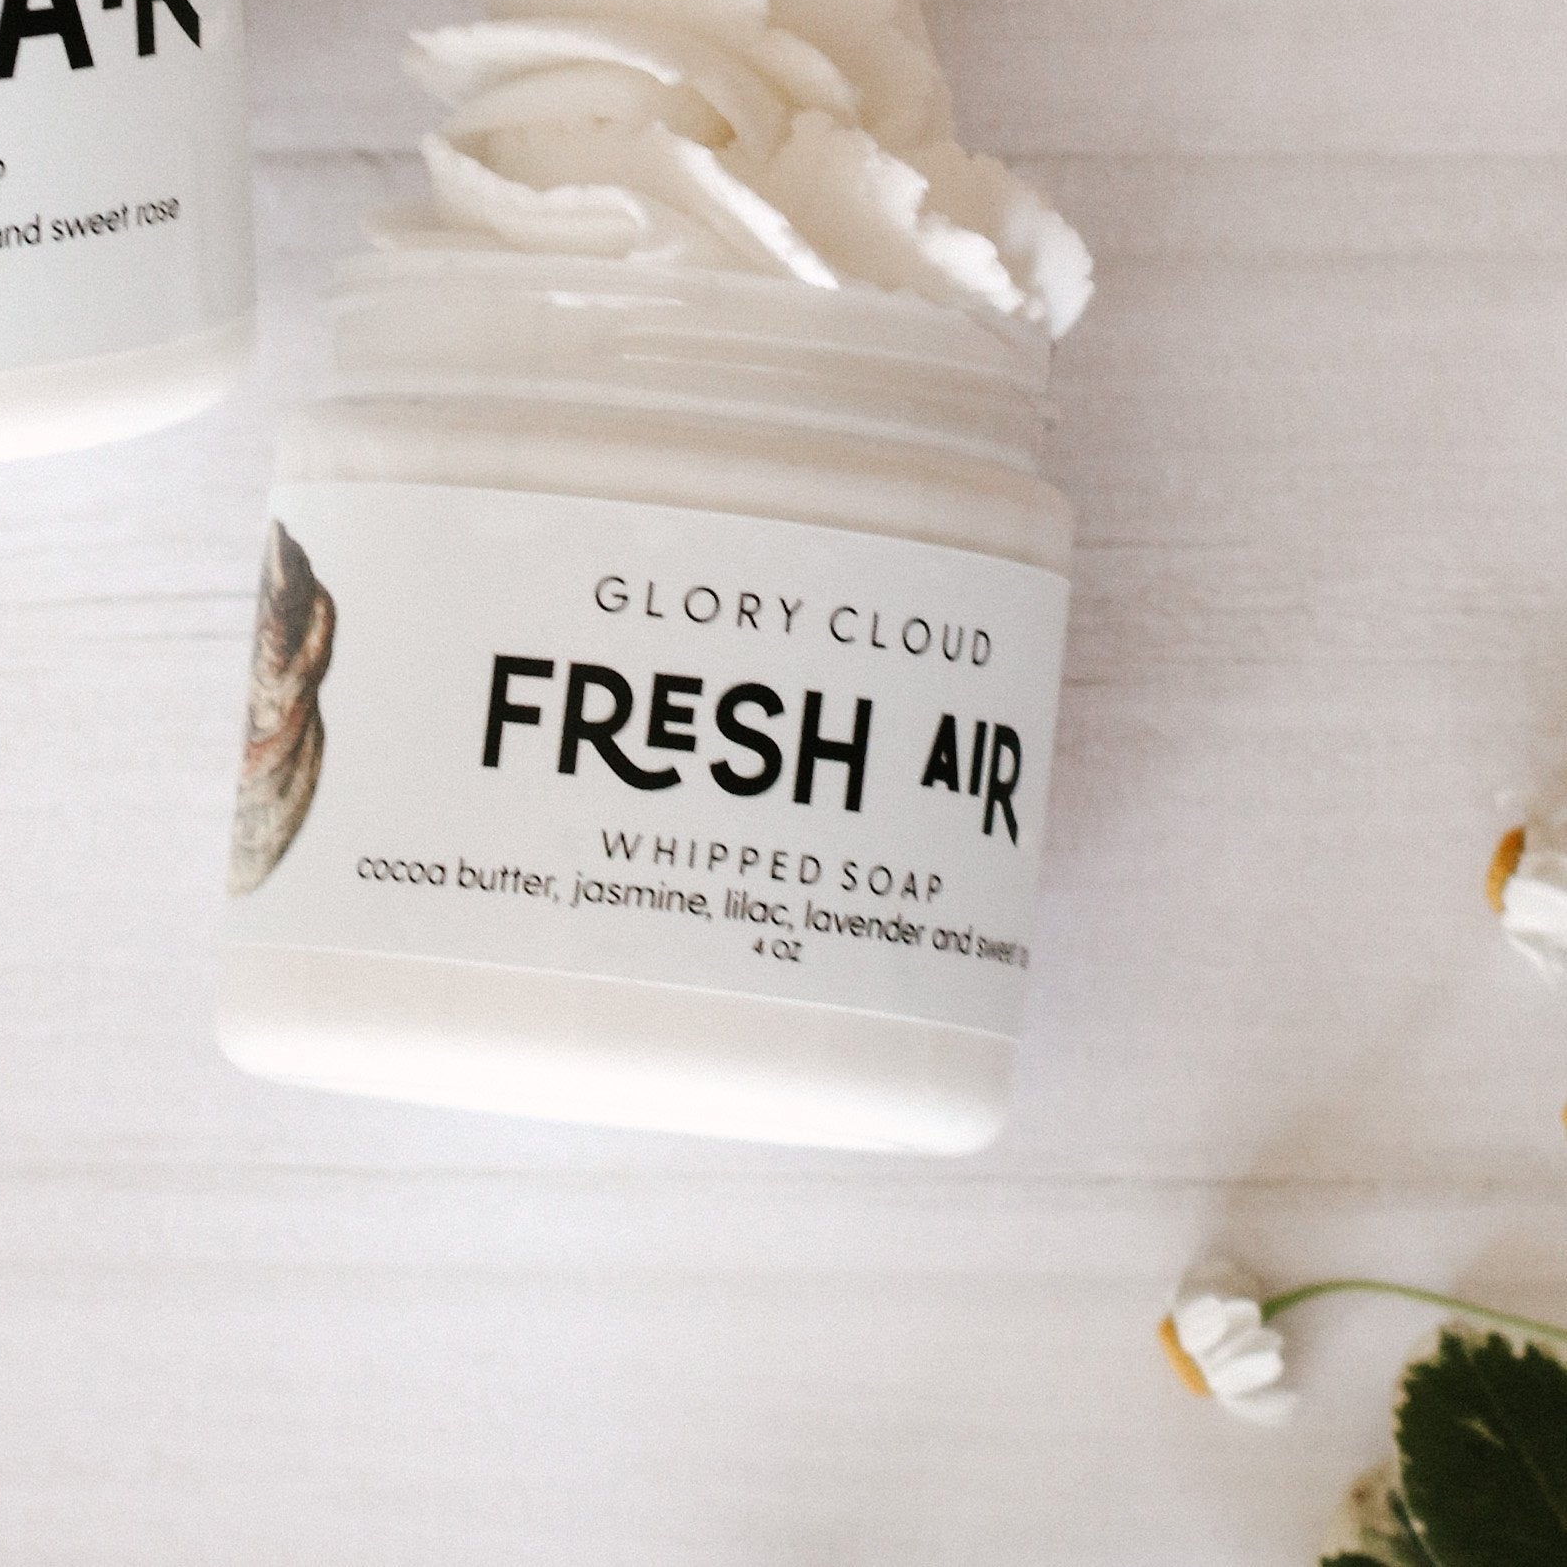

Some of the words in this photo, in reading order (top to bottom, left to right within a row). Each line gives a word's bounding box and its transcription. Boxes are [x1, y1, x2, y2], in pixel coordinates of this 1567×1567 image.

[51, 205, 130, 241] sweet
[135, 196, 182, 227] rose
[594, 575, 805, 636] GLORY
[829, 605, 994, 667] CLOUD
[482, 653, 874, 812] FRESH
[920, 712, 1023, 846] AIR
[357, 857, 445, 884] cocoa
[456, 858, 559, 903] butter,
[569, 870, 712, 920] jasmine,
[724, 886, 794, 930] lilac,
[804, 900, 924, 947] lavender
[932, 924, 973, 955] and
[601, 829, 822, 887] WHIPPED
[840, 861, 946, 903] SOAP
[752, 937, 764, 955] 4
[771, 939, 803, 962] OZ
